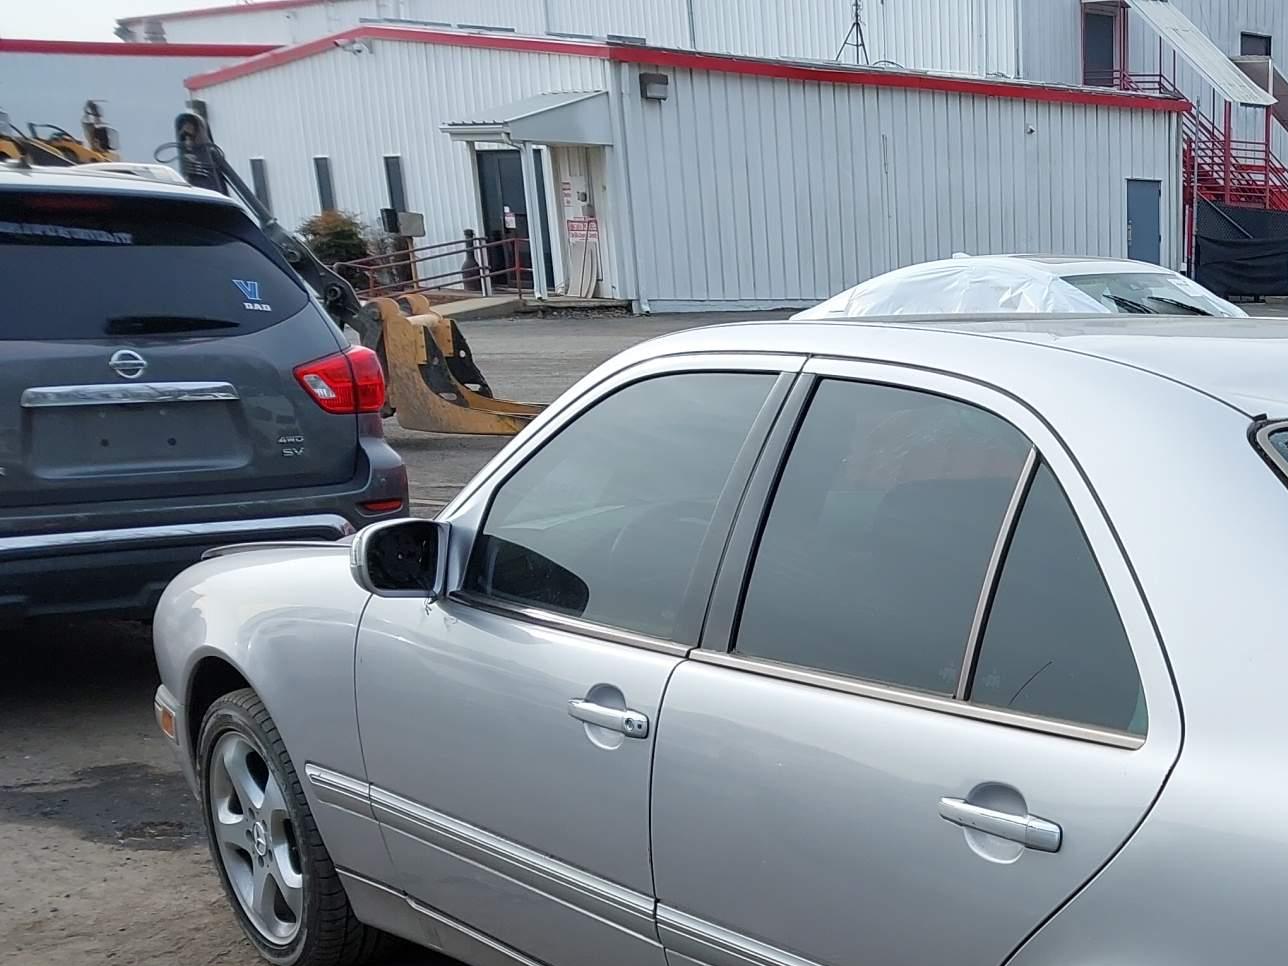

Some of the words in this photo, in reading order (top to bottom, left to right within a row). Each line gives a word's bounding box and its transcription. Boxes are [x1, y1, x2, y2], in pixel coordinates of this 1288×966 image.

[243, 302, 272, 312] DAD
[278, 435, 305, 443] 4WD
[282, 447, 305, 457] SV
